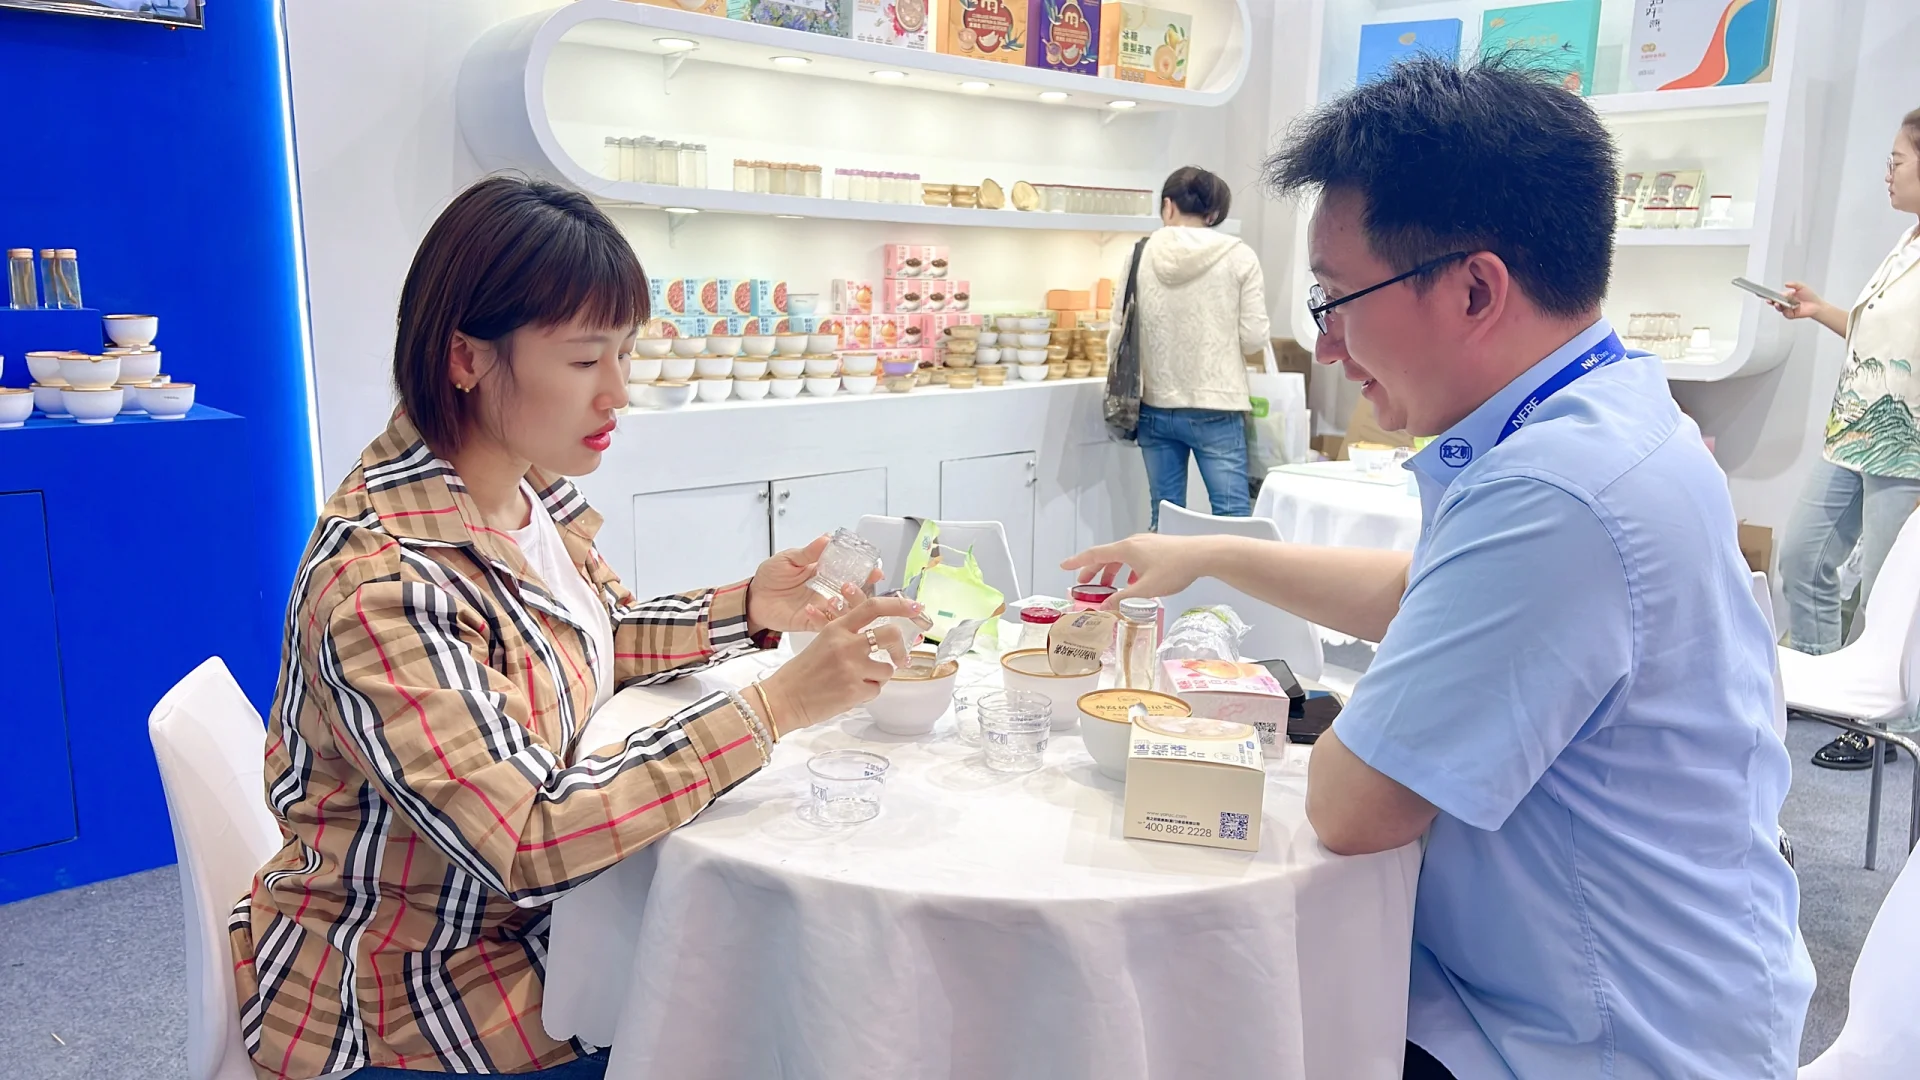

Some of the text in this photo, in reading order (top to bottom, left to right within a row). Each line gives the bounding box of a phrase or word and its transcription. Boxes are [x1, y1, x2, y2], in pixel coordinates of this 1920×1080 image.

[1145, 822, 1212, 838] 400 882 2228
